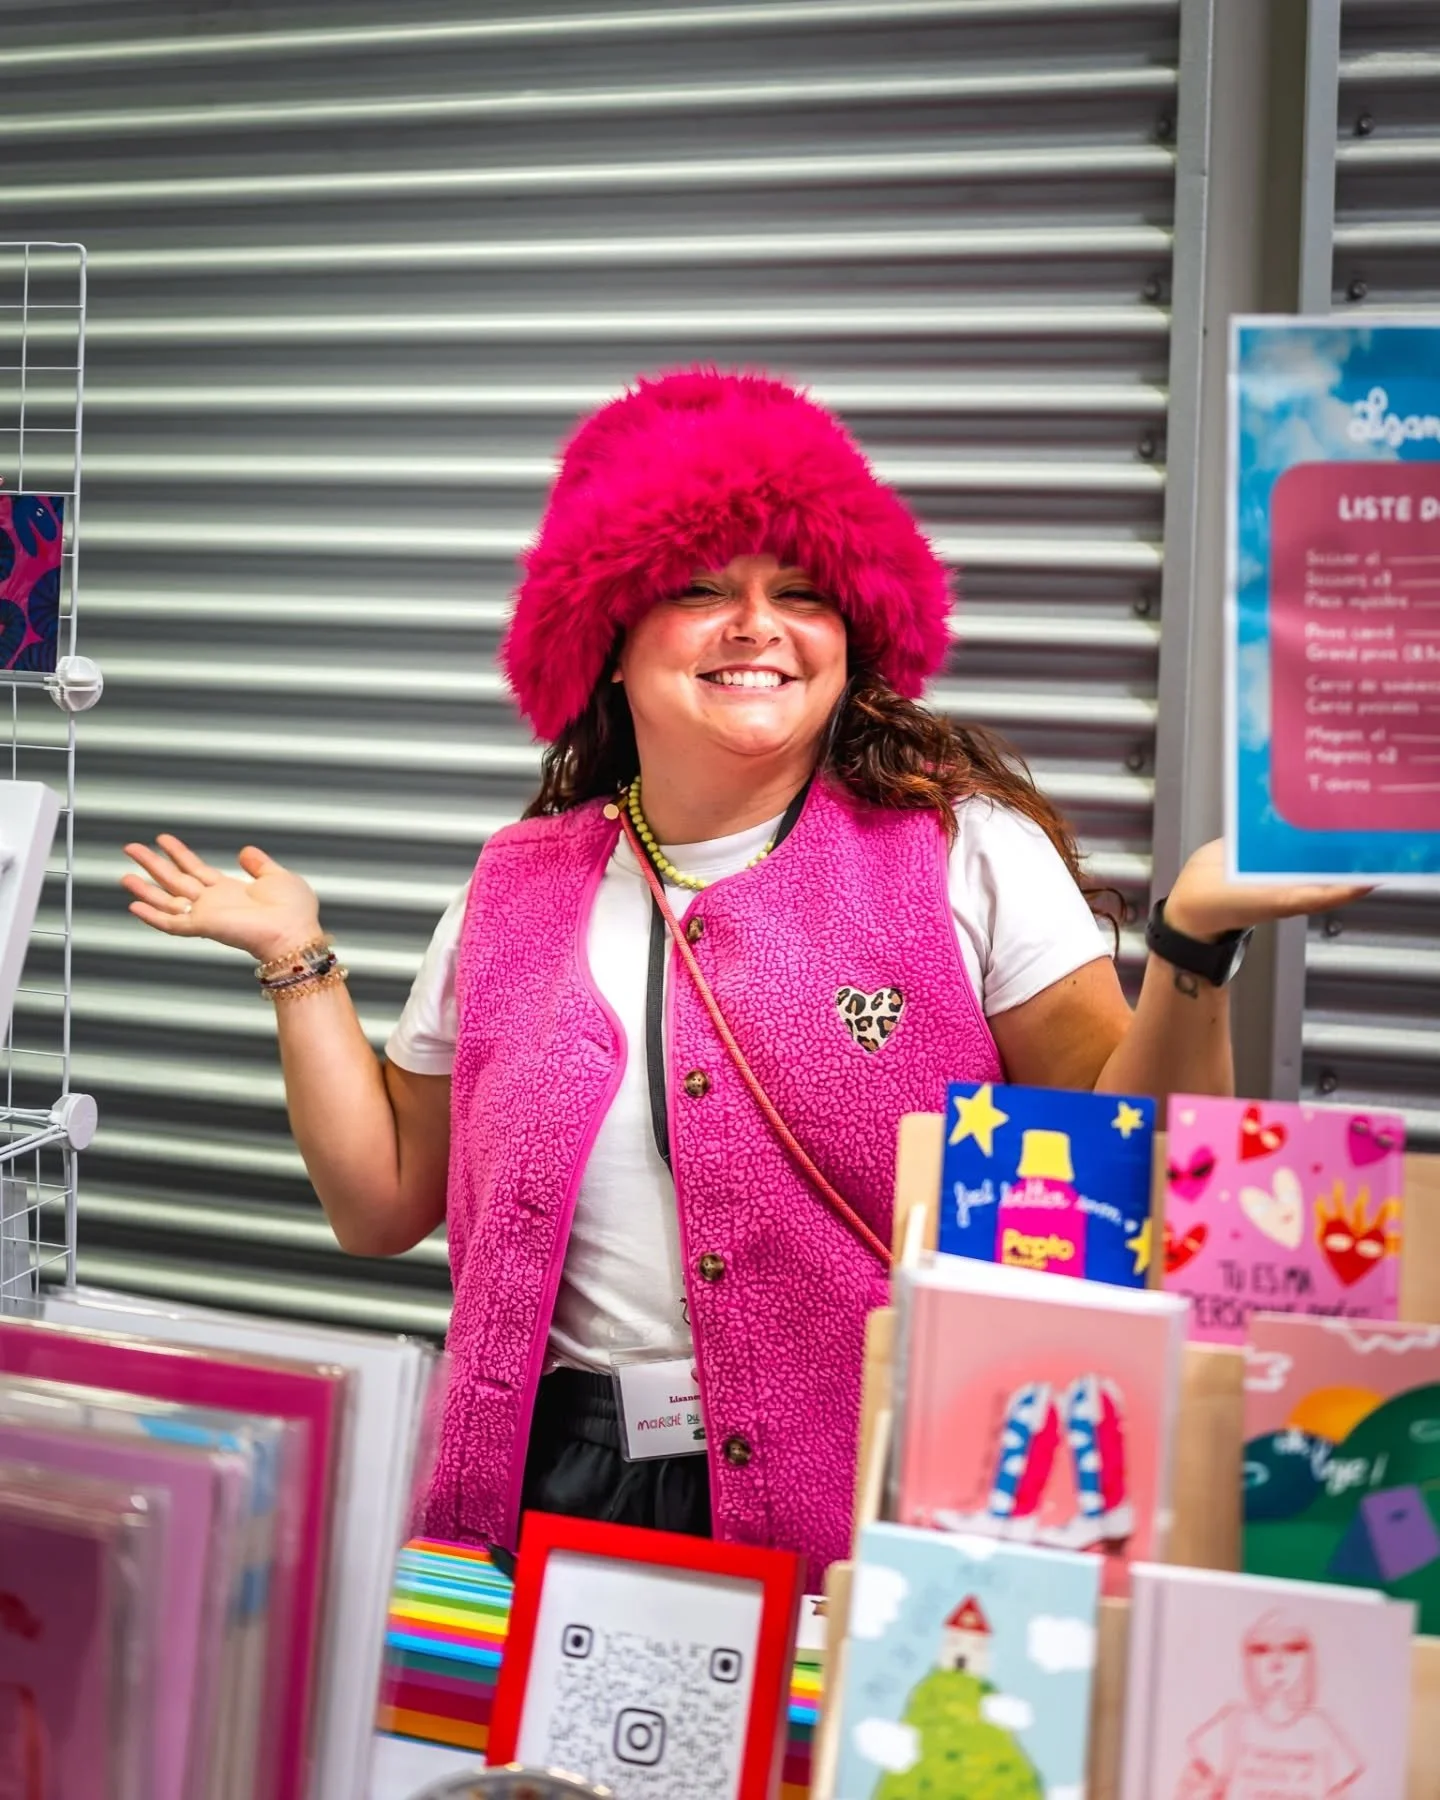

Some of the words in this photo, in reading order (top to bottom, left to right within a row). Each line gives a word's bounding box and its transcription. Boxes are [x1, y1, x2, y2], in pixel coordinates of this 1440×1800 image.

[1338, 496, 1411, 522] LISTE
[1420, 497, 1440, 522] D
[1002, 1228, 1075, 1262] Pepto
[1219, 1260, 1244, 1291] TU
[1253, 1262, 1278, 1293] ES
